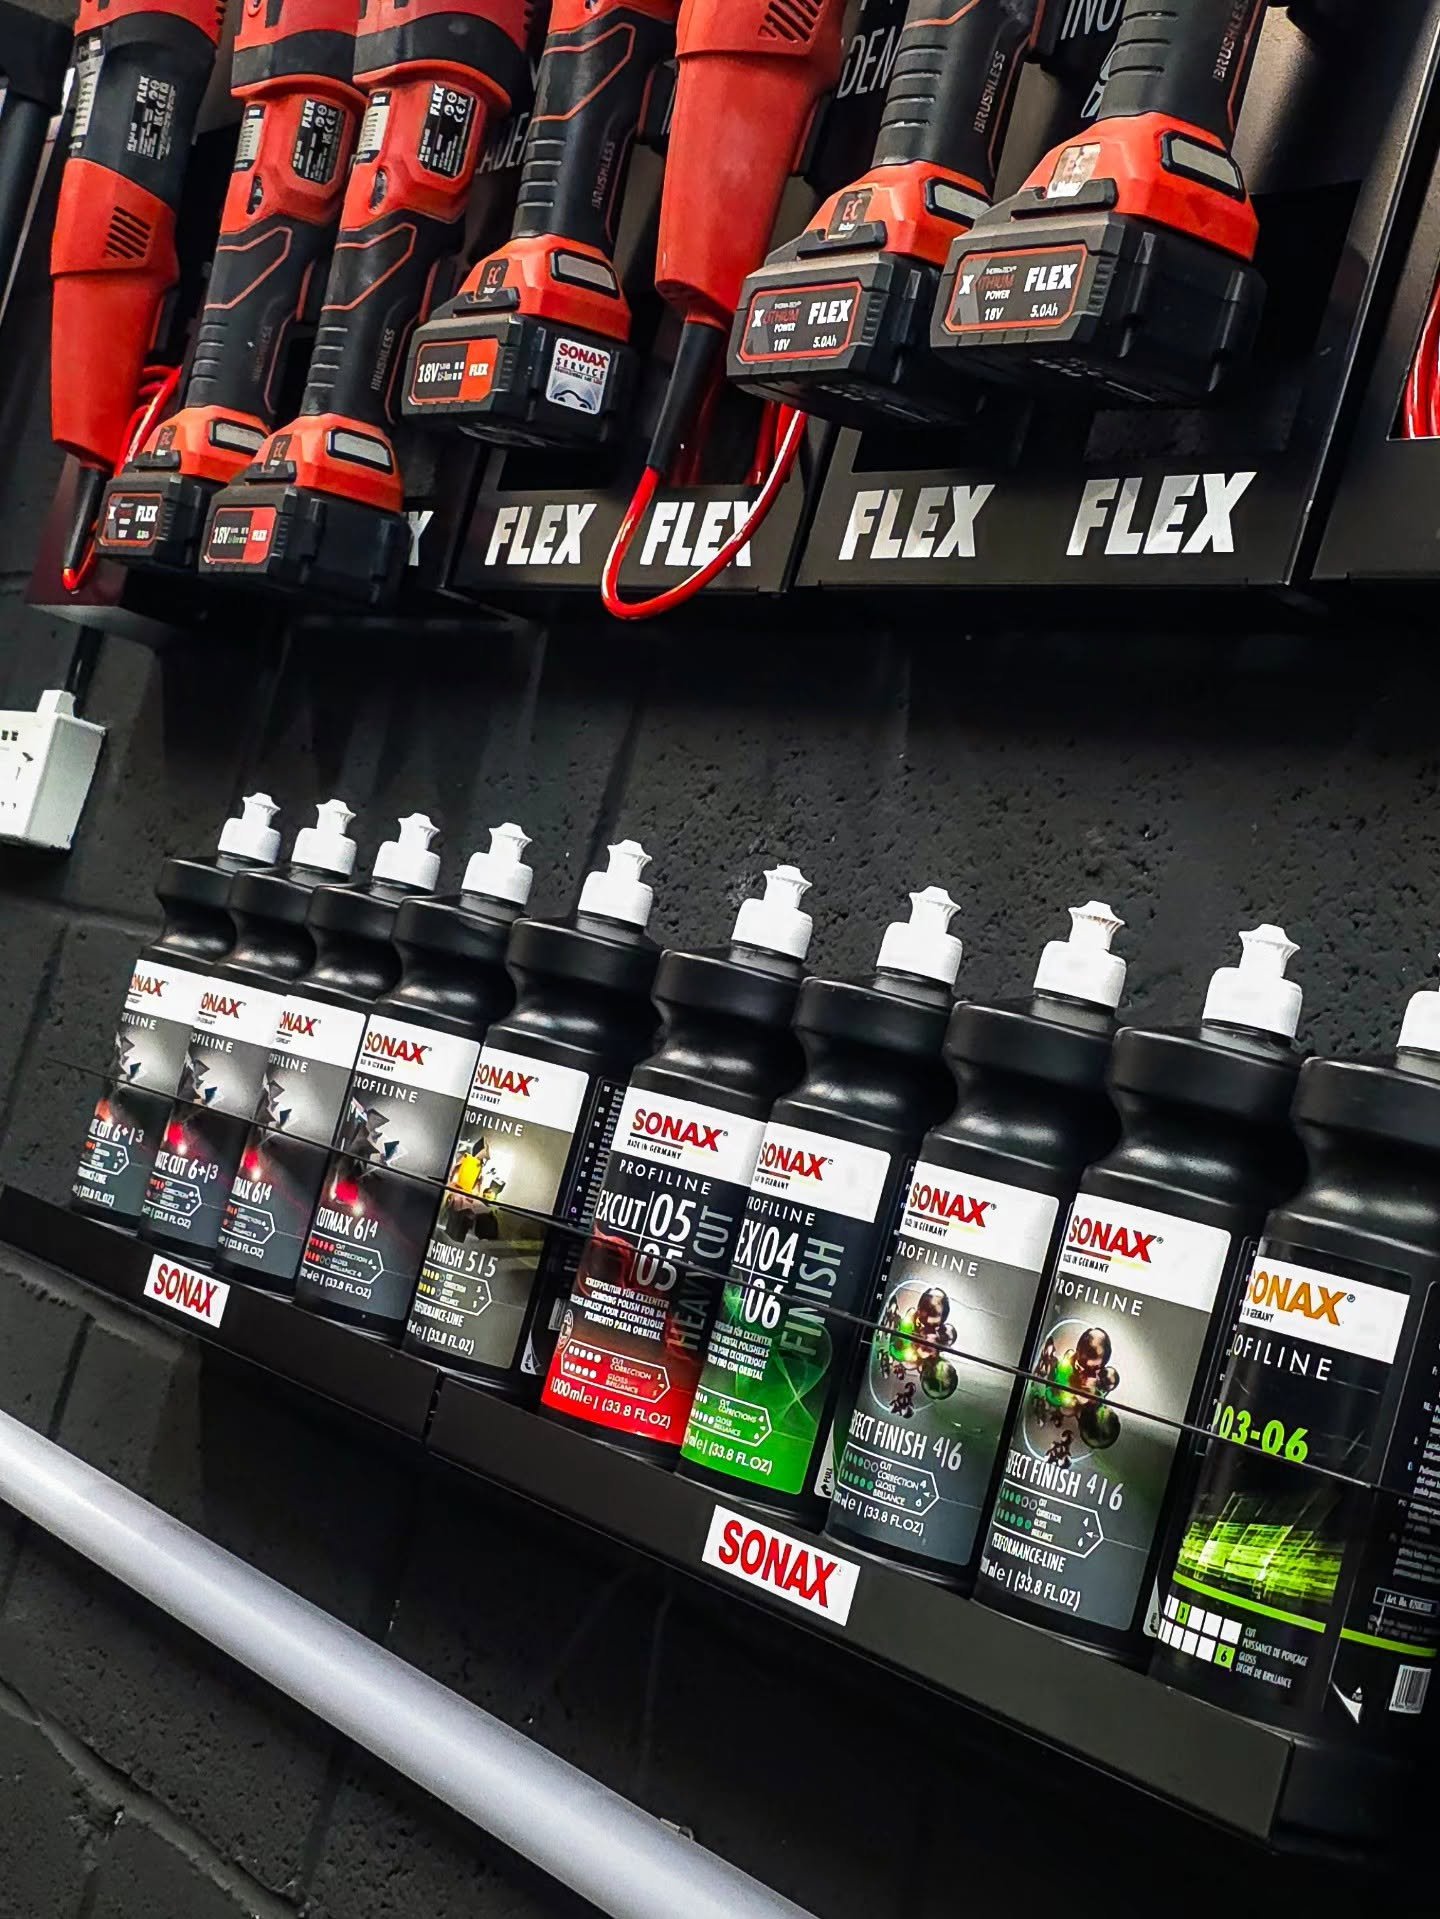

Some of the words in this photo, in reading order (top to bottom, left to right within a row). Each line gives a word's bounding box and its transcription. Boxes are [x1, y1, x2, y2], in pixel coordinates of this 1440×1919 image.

[837, 26, 902, 98] DEN
[430, 83, 446, 117] FLEX
[972, 50, 1006, 134] BRUSHLESS
[959, 274, 975, 295] X
[1024, 263, 1079, 293] FLEX
[985, 289, 1011, 300] POWER
[752, 309, 766, 328] X
[807, 298, 854, 325] FLEX
[985, 306, 1005, 321] 18V
[1029, 302, 1059, 318] 5.0Ah
[773, 322, 796, 333] POWER
[773, 338, 791, 352] 18V
[812, 334, 838, 349] 5.0Ah
[558, 342, 610, 369] SONAX
[417, 362, 440, 383] 18V
[468, 362, 489, 377] FLEX
[555, 357, 606, 381] SERVICE
[135, 505, 159, 522] FLEX
[838, 484, 995, 561] FLEX
[1066, 471, 1257, 556] FLEX
[212, 526, 231, 545] 18V
[484, 503, 598, 566] FLEX
[639, 500, 758, 567] FLEX
[200, 991, 245, 1019] ONAX
[192, 1032, 234, 1053] OFILINE
[364, 1031, 429, 1066] SONAX
[464, 1109, 524, 1138] ROFILINE
[649, 1145, 682, 1160] GERMANY
[619, 1158, 712, 1195] PROFILINE
[316, 1206, 354, 1237] CUTMAX
[594, 1189, 648, 1230] EXCUT
[649, 1193, 697, 1243] 05
[747, 1195, 816, 1226] ROFILINE
[692, 1204, 734, 1259] CUT
[918, 1222, 948, 1237] GERMANY
[733, 1218, 762, 1266] EX
[759, 1225, 800, 1278] 04
[636, 1242, 684, 1292] 05
[1078, 1256, 1110, 1274] GERMANY
[153, 1262, 219, 1318] SONAX
[779, 1237, 845, 1357] FINISH
[616, 1298, 641, 1313] POLISH
[641, 1305, 655, 1317] FOR
[656, 1310, 666, 1320] DA
[744, 1278, 781, 1329] 06
[614, 1319, 632, 1333] PARA
[632, 1326, 661, 1341] ORBITAL
[619, 1310, 665, 1331] EXCENTRIQUE
[1232, 1333, 1333, 1382] OFILINE
[609, 1363, 652, 1380] CORRECTION
[601, 1397, 632, 1417] (33.8
[708, 1441, 735, 1461] (33.8
[873, 1419, 928, 1460] FINISH
[879, 1460, 893, 1471] CUT
[875, 1479, 897, 1493] GLOSS
[877, 1469, 920, 1491] CORRECTION
[1029, 1459, 1082, 1498] FINISH
[872, 1488, 906, 1506] BRILLANCE
[863, 1504, 888, 1523] (33.8
[718, 1519, 838, 1609] SONAX
[991, 1531, 1067, 1574] PERFORMANCE-LINE
[1013, 1570, 1043, 1595] (33.8
[1244, 1626, 1257, 1638] CUT
[1220, 1649, 1229, 1663] 6
[1238, 1651, 1258, 1666] GLOSS
[1241, 1638, 1273, 1656] PUISSANCE
[1262, 1670, 1294, 1690] BRILLANCE
